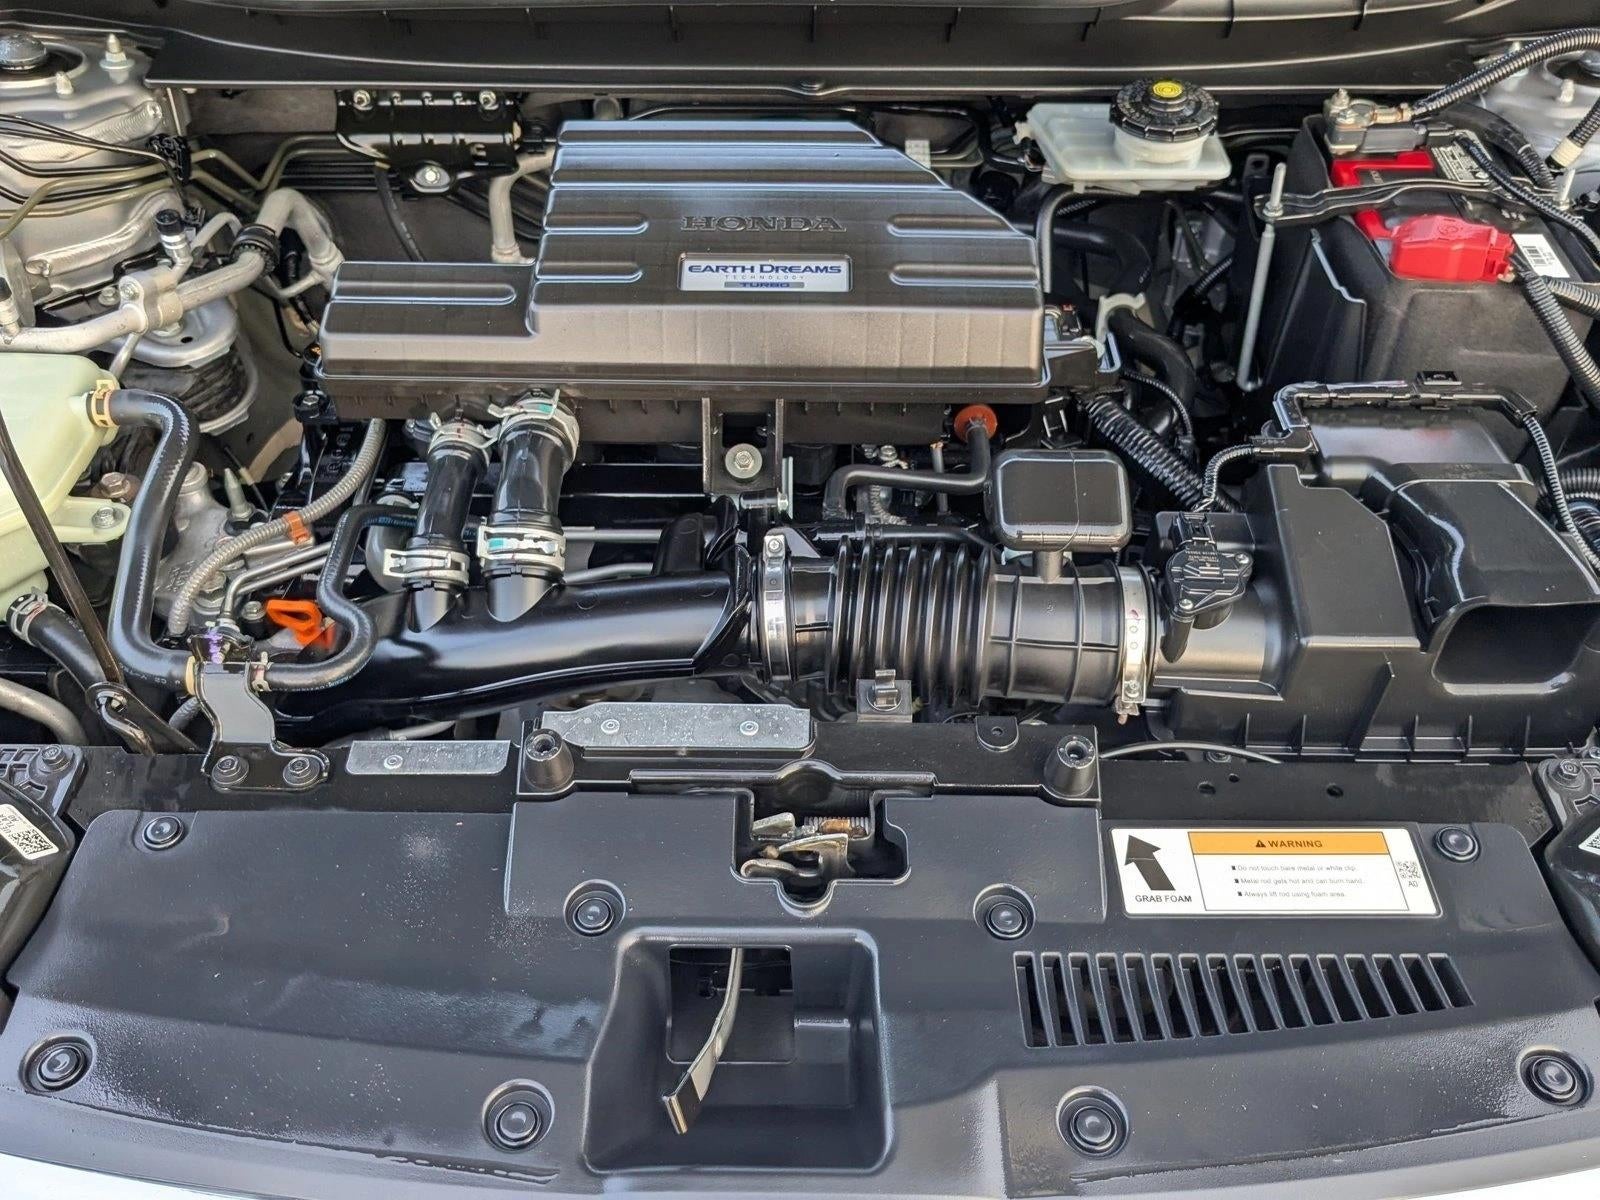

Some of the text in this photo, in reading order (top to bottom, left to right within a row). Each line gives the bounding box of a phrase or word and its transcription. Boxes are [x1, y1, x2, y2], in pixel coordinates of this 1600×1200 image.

[681, 215, 847, 232] HONDA
[688, 263, 842, 274] EARTH DREAMS
[1268, 839, 1323, 848] WARNING
[1135, 894, 1192, 903] GRAB FOAM
